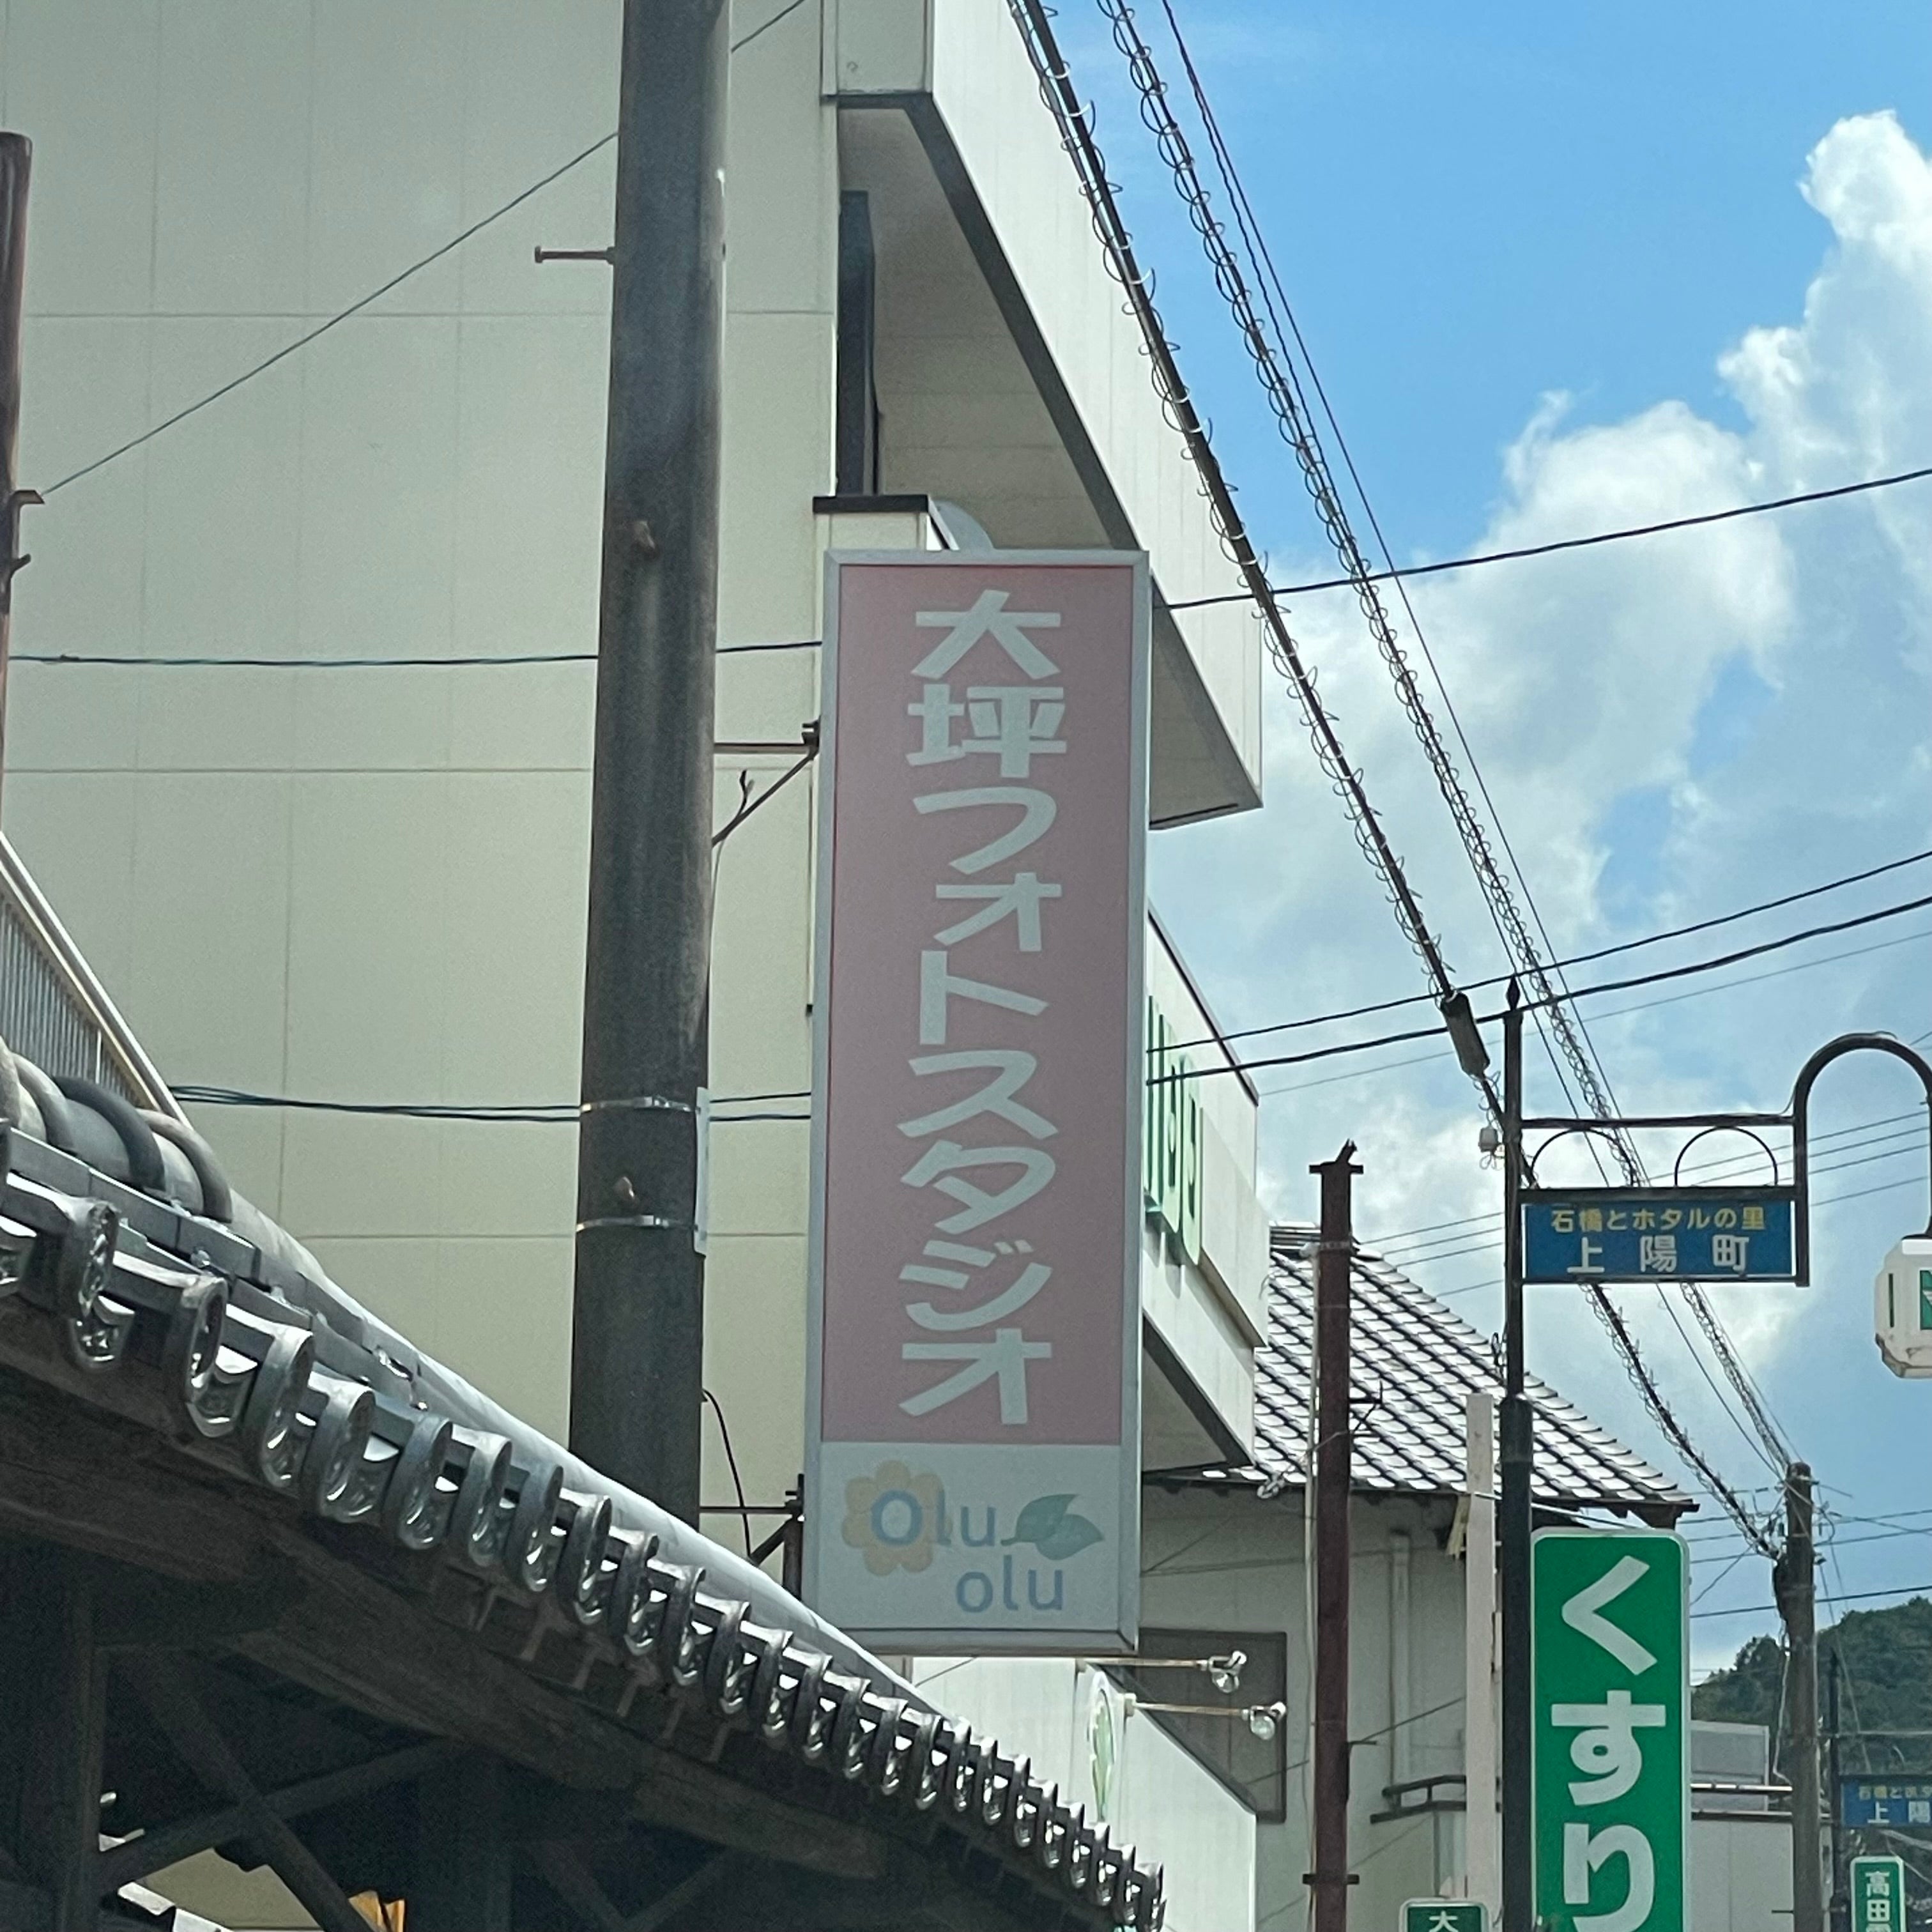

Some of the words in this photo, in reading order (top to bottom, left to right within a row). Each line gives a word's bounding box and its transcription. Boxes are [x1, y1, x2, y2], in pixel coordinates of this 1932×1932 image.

[897, 588, 1067, 1425] 大坪フォトスタジオ
[1551, 1206, 1766, 1233] 石橋とホタルの里
[1567, 1234, 1749, 1273] 上陽町
[956, 1554, 1063, 1613] olu
[1551, 1554, 1666, 1932] くすり
